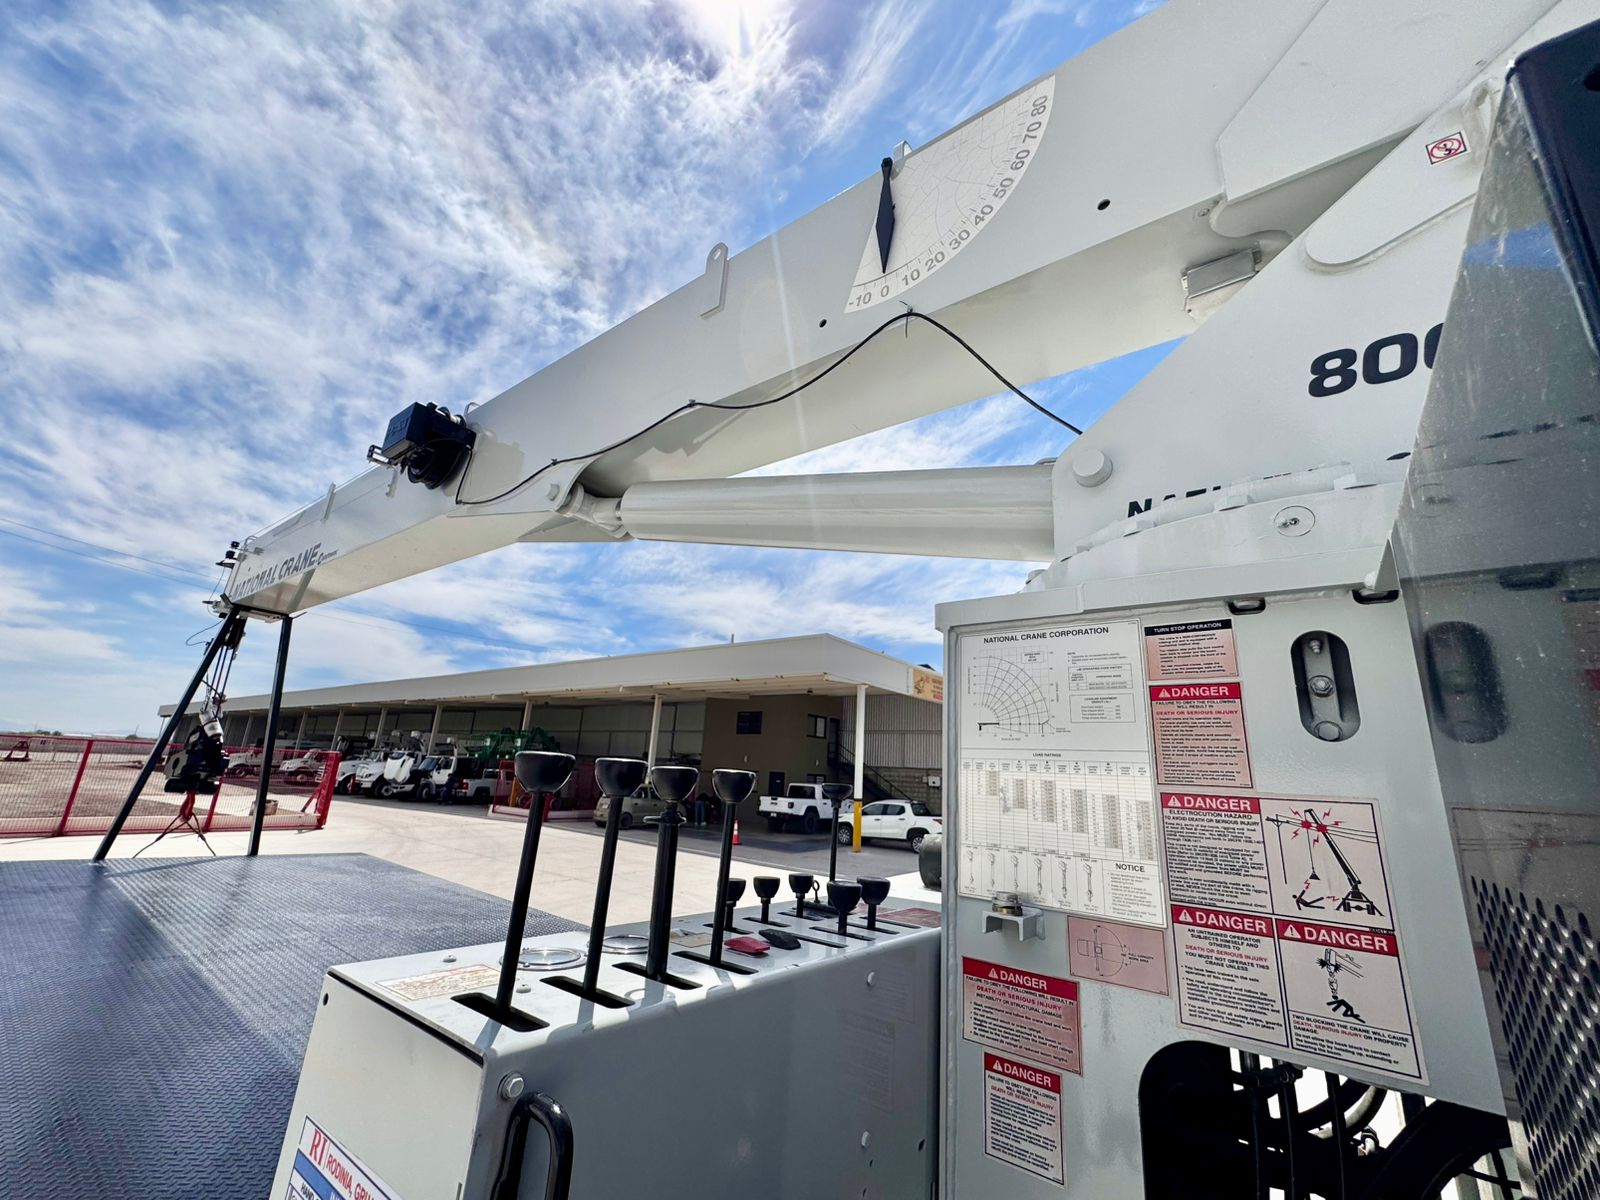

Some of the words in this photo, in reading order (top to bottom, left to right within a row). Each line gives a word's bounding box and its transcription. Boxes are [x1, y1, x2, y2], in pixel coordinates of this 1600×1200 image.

[1031, 95, 1047, 116] 80
[1022, 121, 1041, 143] 70
[1010, 149, 1030, 170] 60
[993, 177, 1014, 199] 50
[975, 204, 993, 225] 40
[949, 229, 970, 249] 30
[925, 251, 945, 272] 20
[902, 269, 920, 285] 10
[848, 291, 872, 306] -10
[881, 285, 889, 297] 0
[233, 565, 277, 599] NATIONAL
[279, 543, 321, 579] CRANE
[984, 635, 1019, 644] NATIONAL
[1049, 627, 1109, 638] CORPORATION
[1187, 622, 1222, 630] OPERATION
[1172, 687, 1229, 697] DANGER
[1169, 809, 1222, 818] ELECTROCUTION
[1184, 797, 1251, 811] DANGER
[1116, 863, 1145, 872] NOTICE
[1196, 912, 1267, 933] DANGER
[1191, 933, 1218, 942] SUBJECTS
[1220, 938, 1245, 946] HIMSELF
[1196, 929, 1228, 938] UNTRAINED
[1229, 934, 1261, 943] OPERATOR
[1208, 941, 1231, 950] OTHERS
[1304, 927, 1388, 952] DANGER
[1185, 944, 1205, 952] DEATH
[1216, 948, 1243, 959] SERIOUS
[1244, 954, 1268, 963] INJURY
[1205, 960, 1225, 968] CRANE
[1226, 963, 1248, 971] UNLESS
[1228, 958, 1254, 968] OPERATE
[1256, 962, 1270, 970] THIS
[1000, 970, 1047, 991] DANGER
[976, 986, 996, 995] DEATH
[1008, 993, 1035, 1005] SERIOUS
[1037, 1001, 1062, 1011] INJURY
[1010, 1000, 1040, 1014] STRUCTURAL
[1306, 1017, 1335, 1027] BLOCKING
[1350, 1026, 1370, 1034] CRANE
[1371, 1030, 1387, 1038] WILL
[1388, 1034, 1409, 1042] CAUSE
[1314, 1024, 1340, 1034] SERIOUS
[1341, 1030, 1362, 1038] INJURY
[1374, 1037, 1407, 1048] PROPERTY
[1004, 1063, 1052, 1088] DANGER
[991, 1085, 1006, 1093] DEATH
[1015, 1093, 1035, 1105] SERIOUS
[1036, 1100, 1054, 1111] INJURY
[310, 1128, 328, 1166] RI
[326, 1153, 352, 1197] RODINIA,
